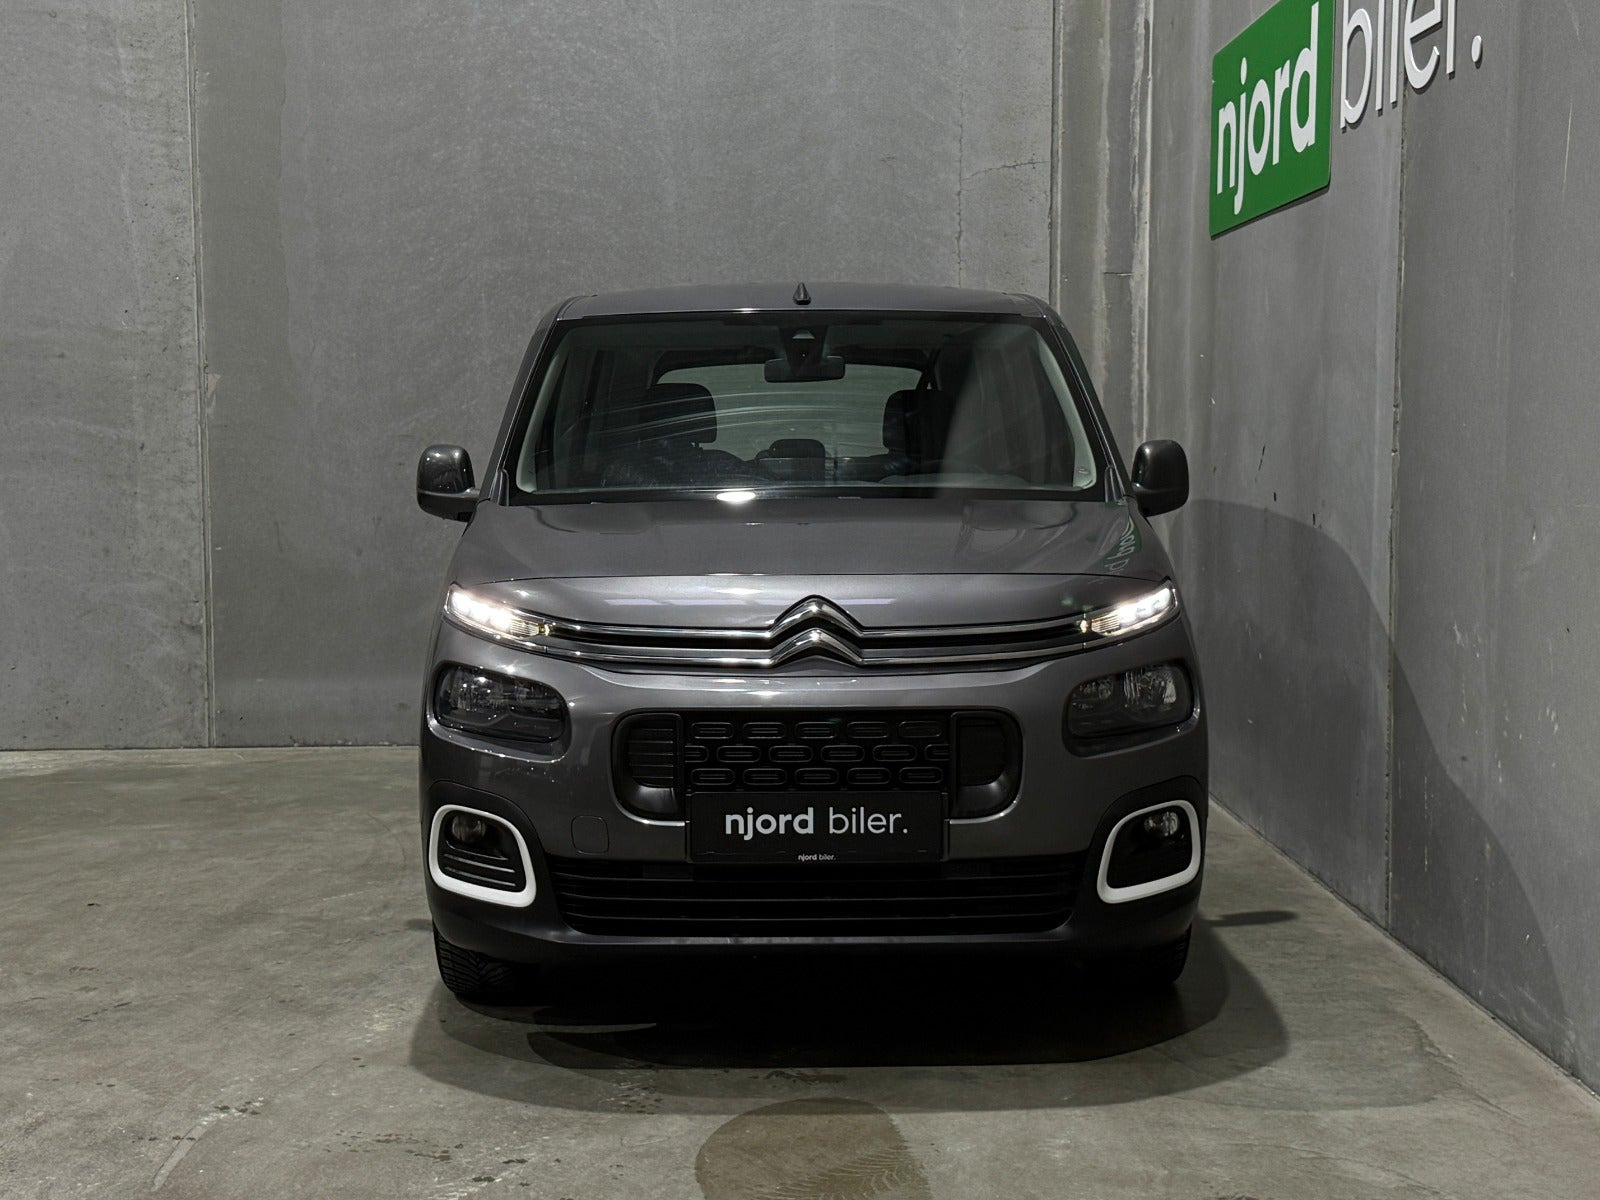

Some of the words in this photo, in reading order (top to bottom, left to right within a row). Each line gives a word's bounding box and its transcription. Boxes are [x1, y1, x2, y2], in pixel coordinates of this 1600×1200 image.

[1217, 2, 1319, 215] njord
[725, 807, 814, 841] njord
[829, 807, 908, 834] biler.
[798, 853, 817, 861] njord
